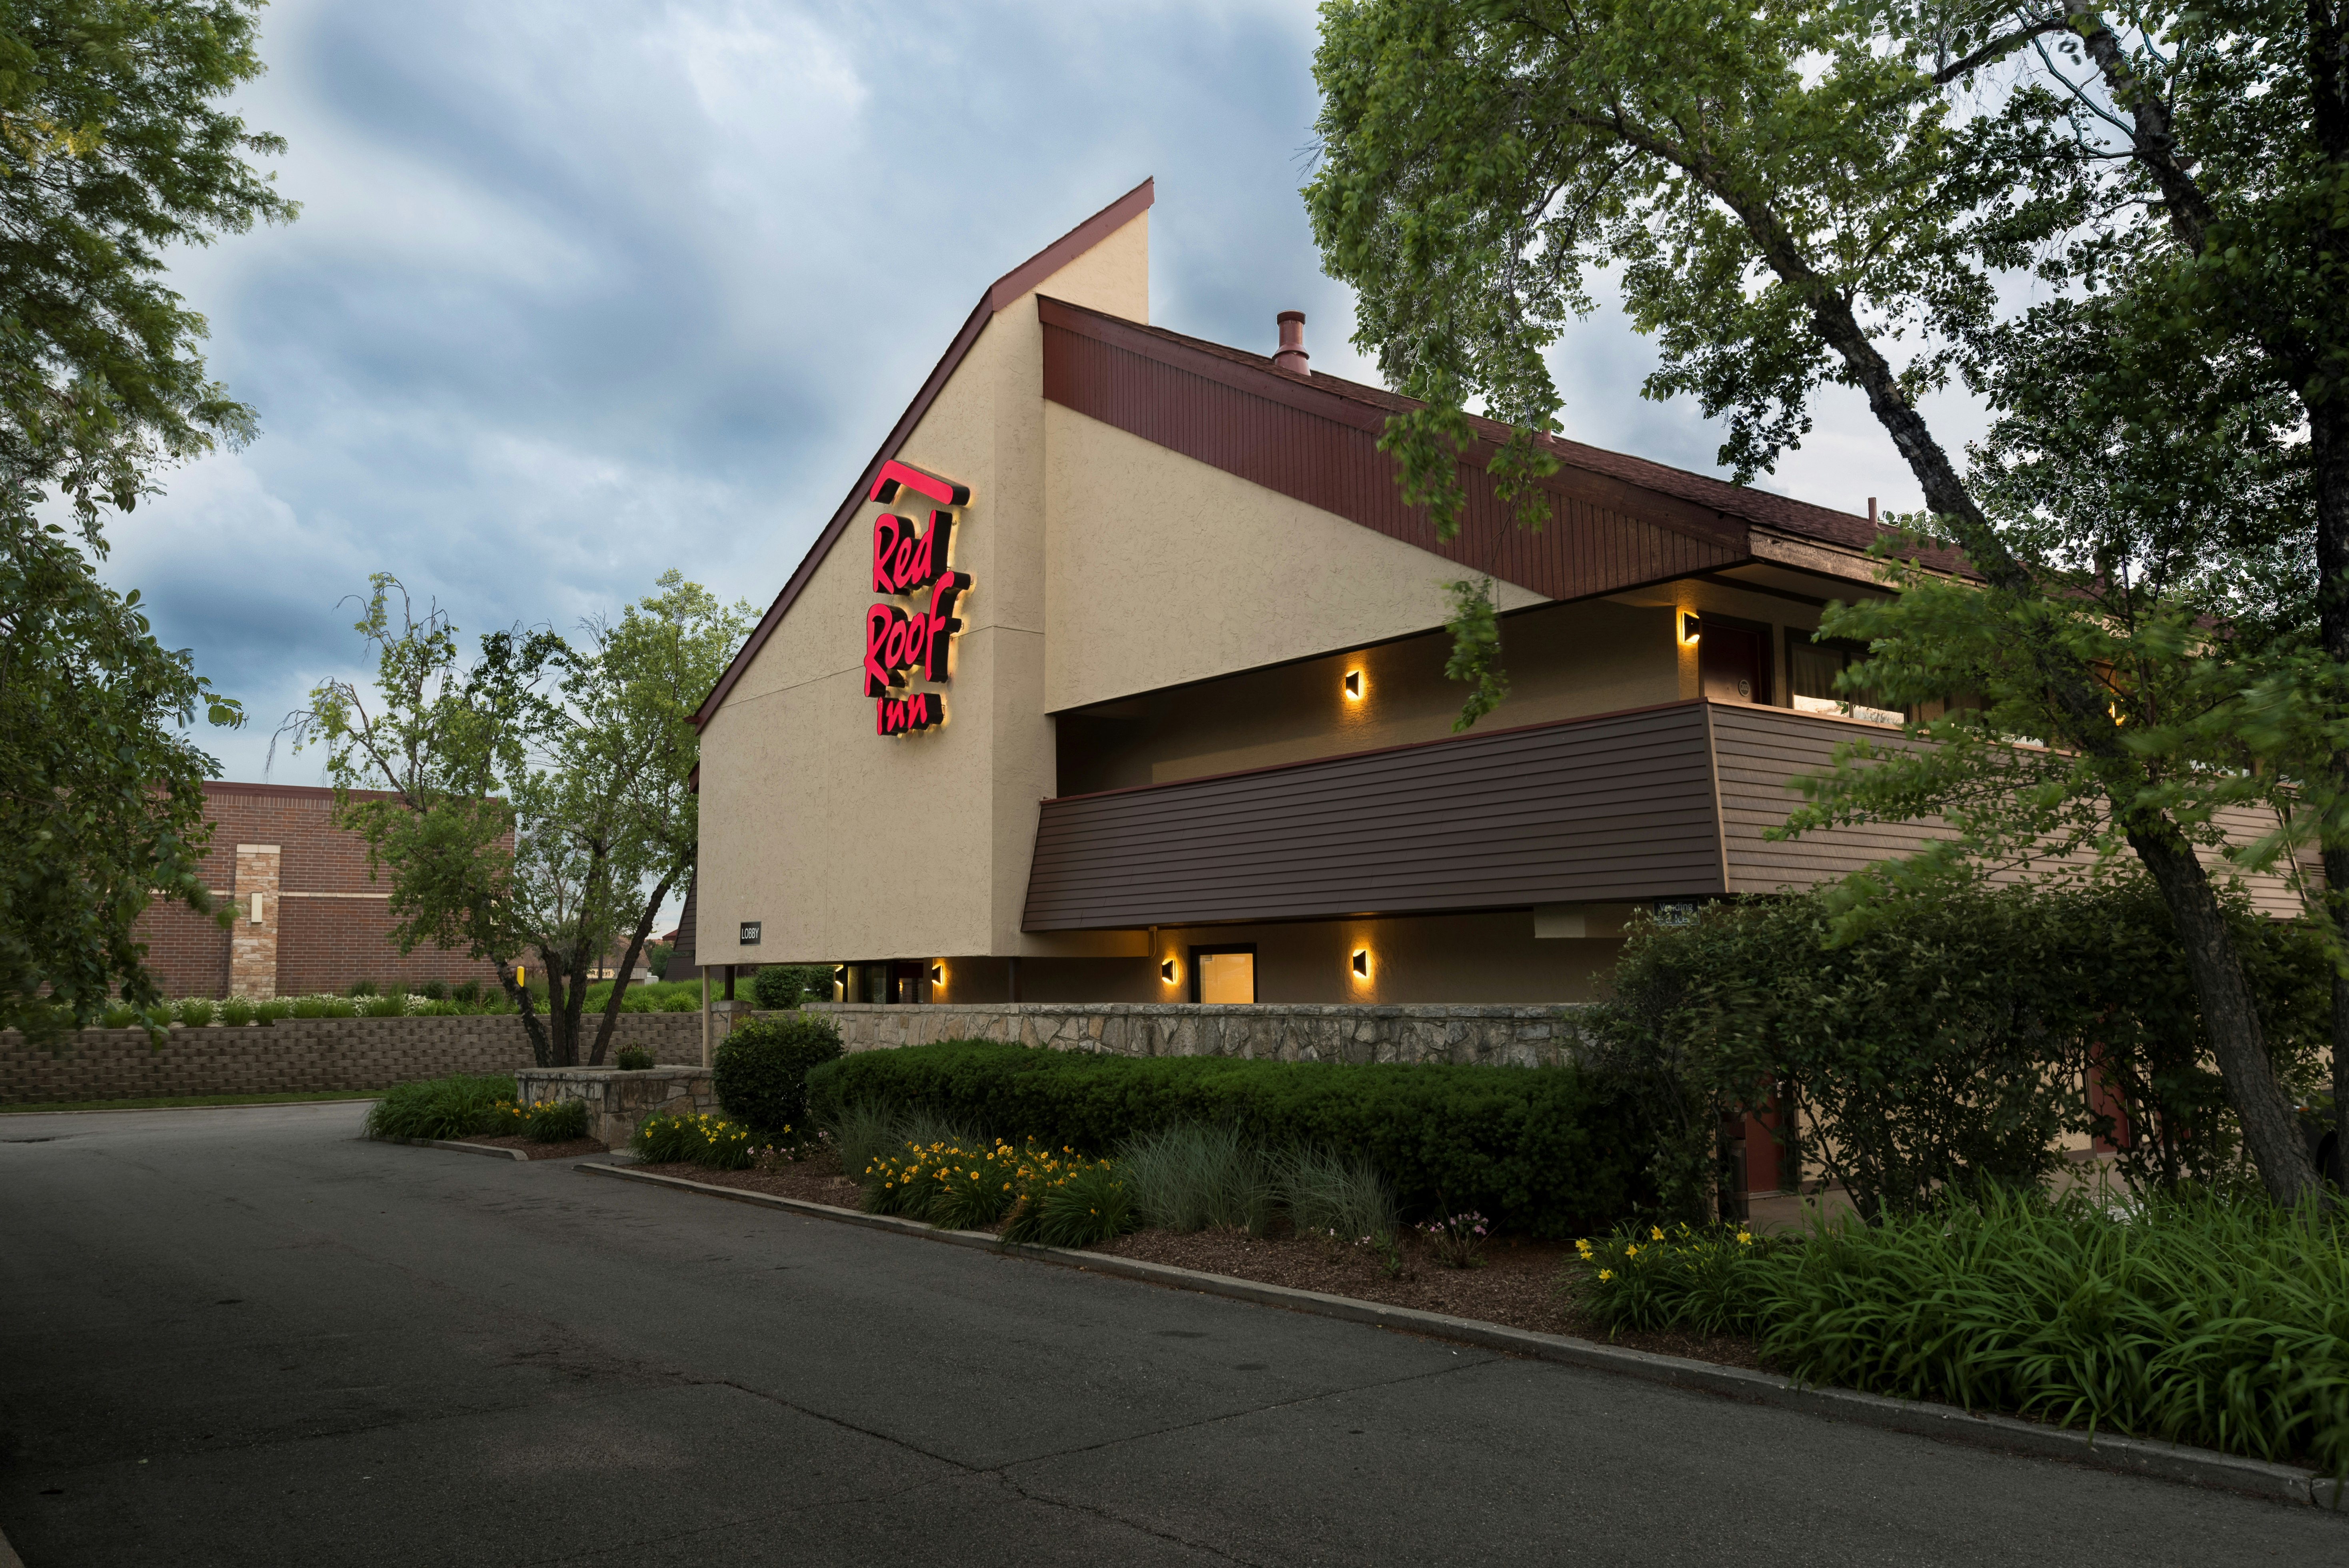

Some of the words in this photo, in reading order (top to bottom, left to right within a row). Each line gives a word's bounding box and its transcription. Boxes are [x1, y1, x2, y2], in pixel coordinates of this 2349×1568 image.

[873, 509, 937, 595] Red
[864, 571, 955, 697] Roof
[1659, 902, 1693, 913] Vnding
[741, 928, 759, 939] LOBBY
